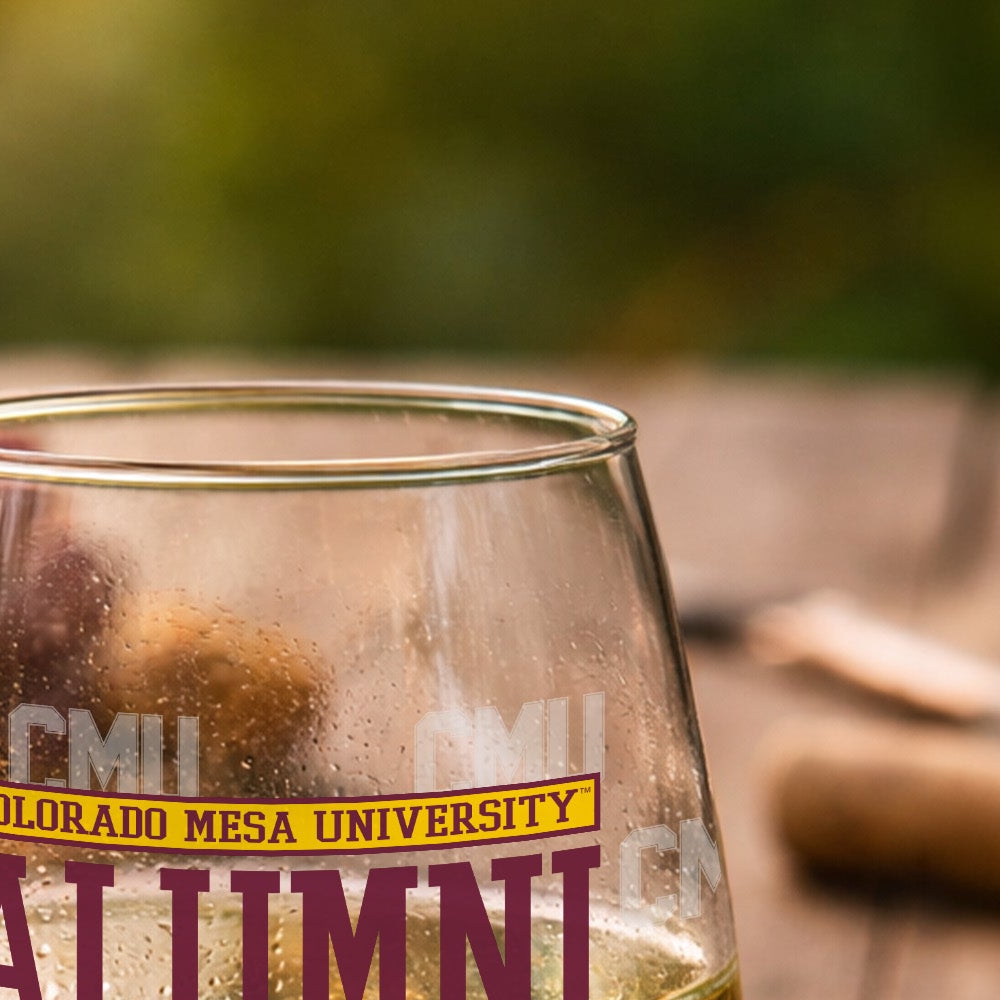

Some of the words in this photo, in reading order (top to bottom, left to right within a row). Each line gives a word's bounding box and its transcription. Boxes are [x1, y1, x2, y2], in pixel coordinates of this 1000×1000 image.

[8, 703, 200, 797] CMU
[414, 691, 605, 792] CMU
[184, 809, 298, 844] MESA
